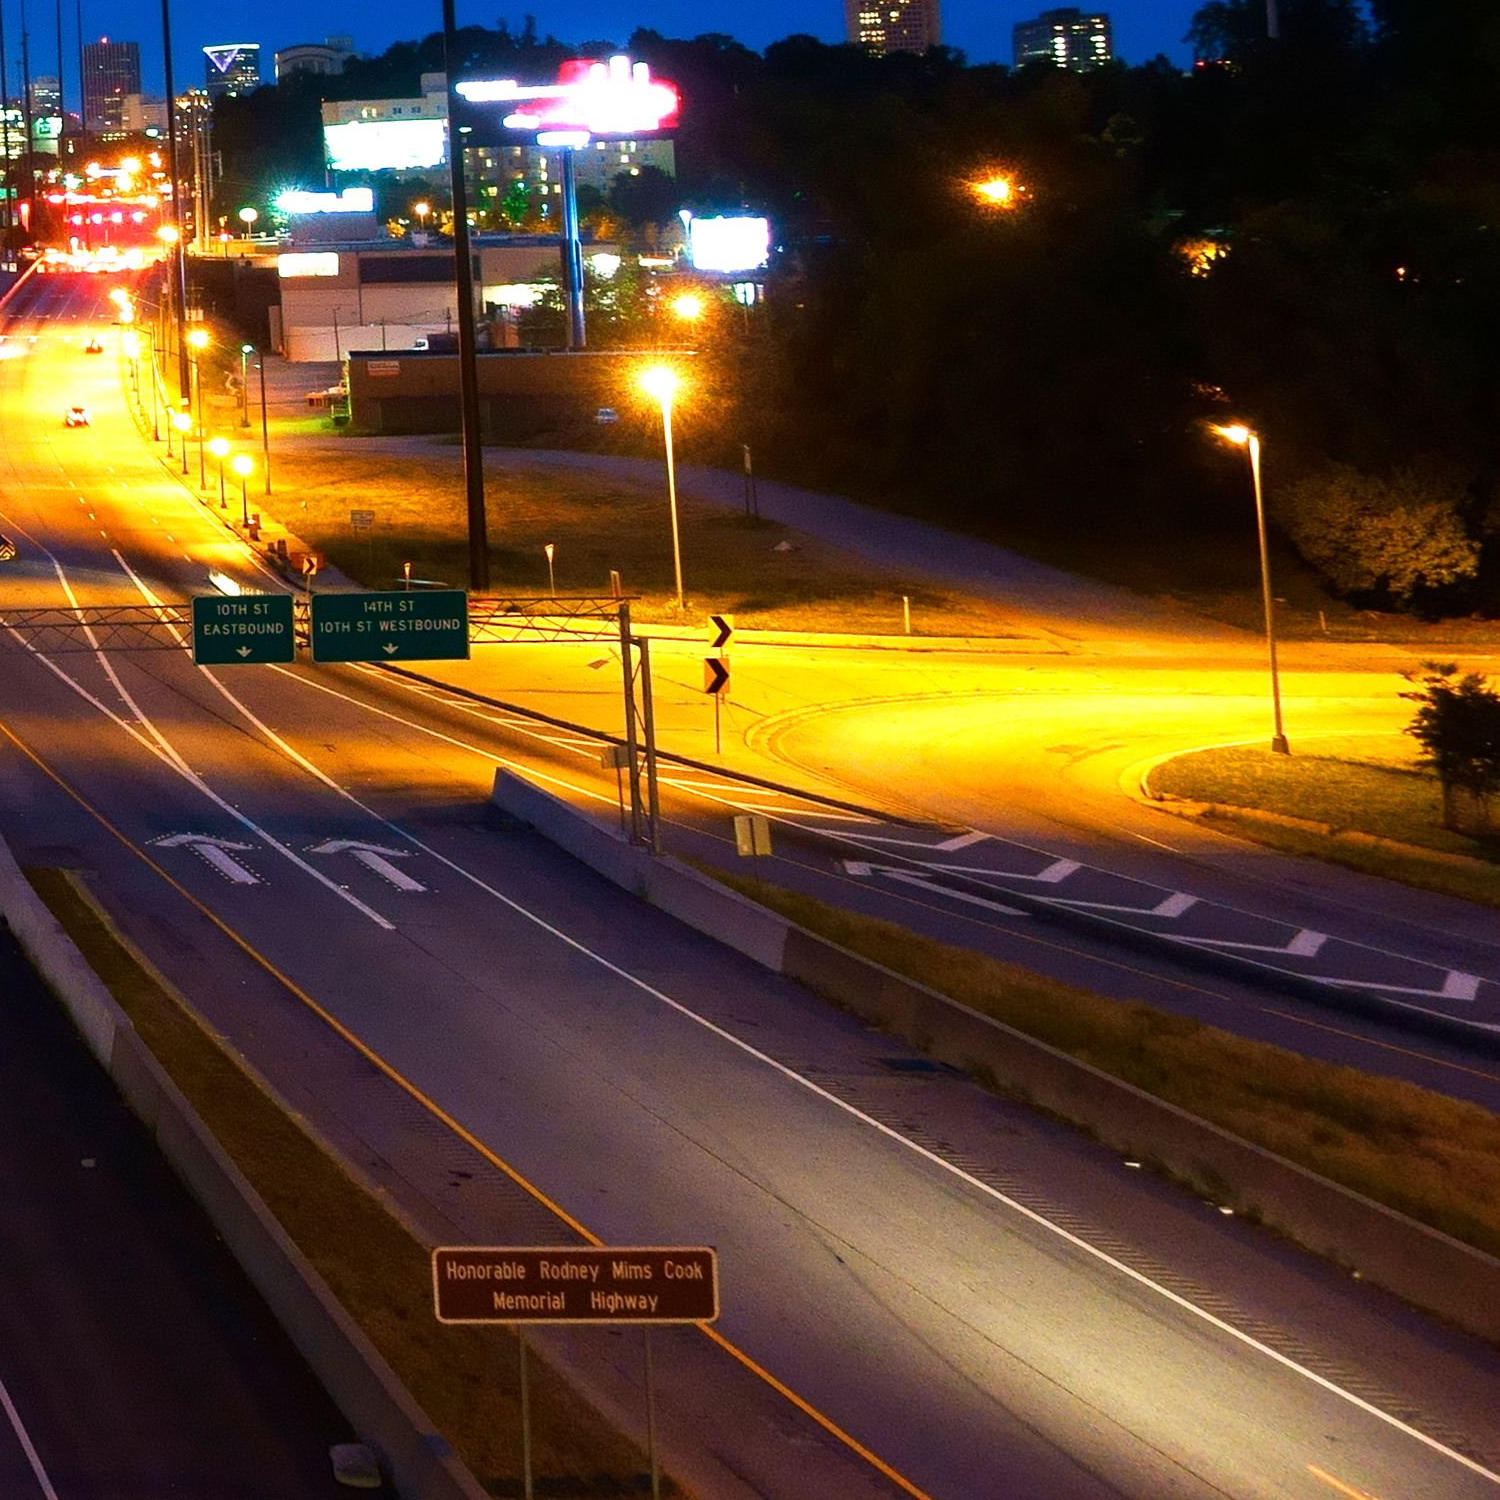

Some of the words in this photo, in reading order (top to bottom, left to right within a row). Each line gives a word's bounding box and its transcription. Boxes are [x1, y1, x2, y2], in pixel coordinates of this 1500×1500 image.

[217, 603, 248, 616] 10TH
[253, 603, 270, 615] ST
[363, 601, 393, 613] 14TH
[399, 600, 415, 612] ST
[203, 622, 284, 636] EASTBOUND
[320, 621, 351, 634] 10TH
[356, 620, 373, 632] ST
[379, 618, 461, 632] WESTBOUND
[446, 1261, 526, 1280] Honorable
[539, 1261, 599, 1283] Rodney
[612, 1261, 653, 1280] Mims
[664, 1260, 703, 1280] Cook
[493, 1291, 566, 1310] Memorial
[590, 1291, 658, 1313] Highway
